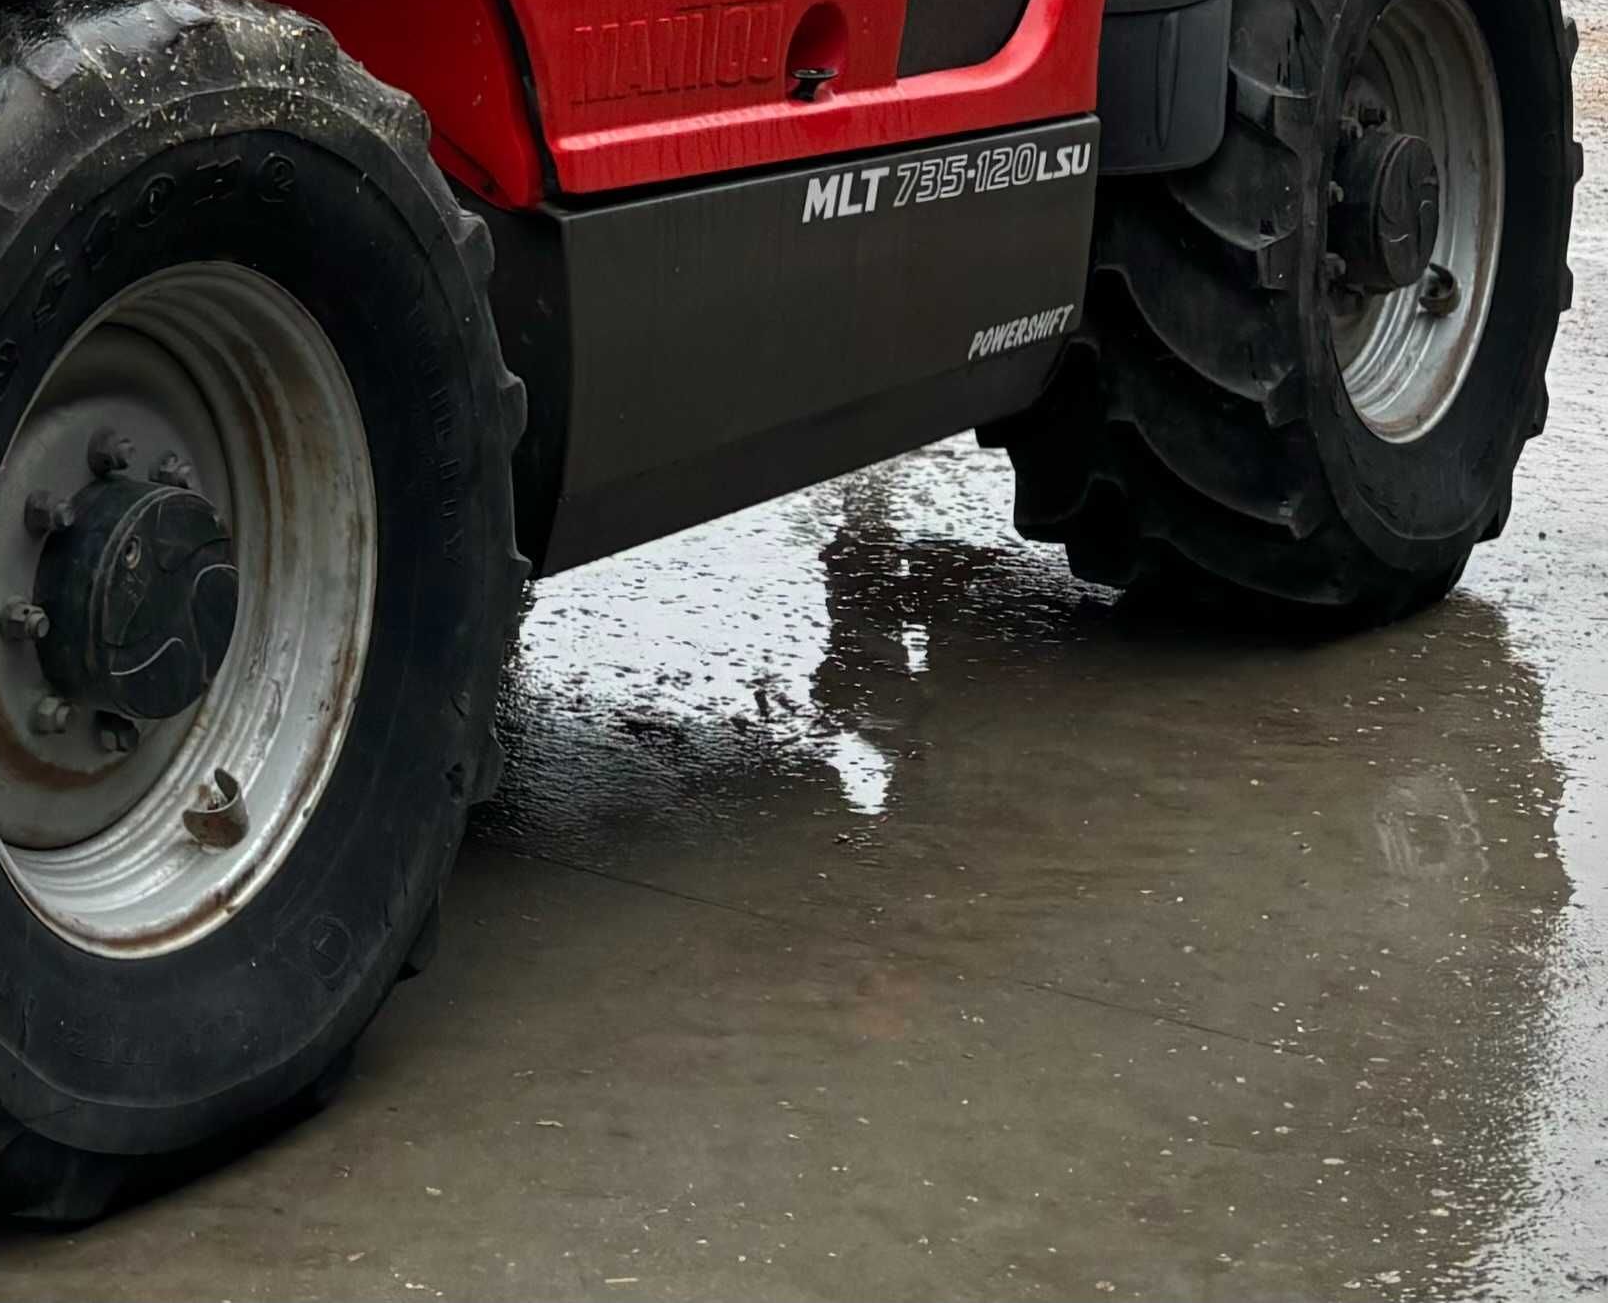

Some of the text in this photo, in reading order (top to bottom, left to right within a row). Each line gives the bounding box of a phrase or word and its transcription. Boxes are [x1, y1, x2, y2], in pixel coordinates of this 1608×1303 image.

[802, 166, 890, 224] MLT
[1036, 142, 1091, 182] LSU
[967, 304, 1074, 361] POWERSHIFT
